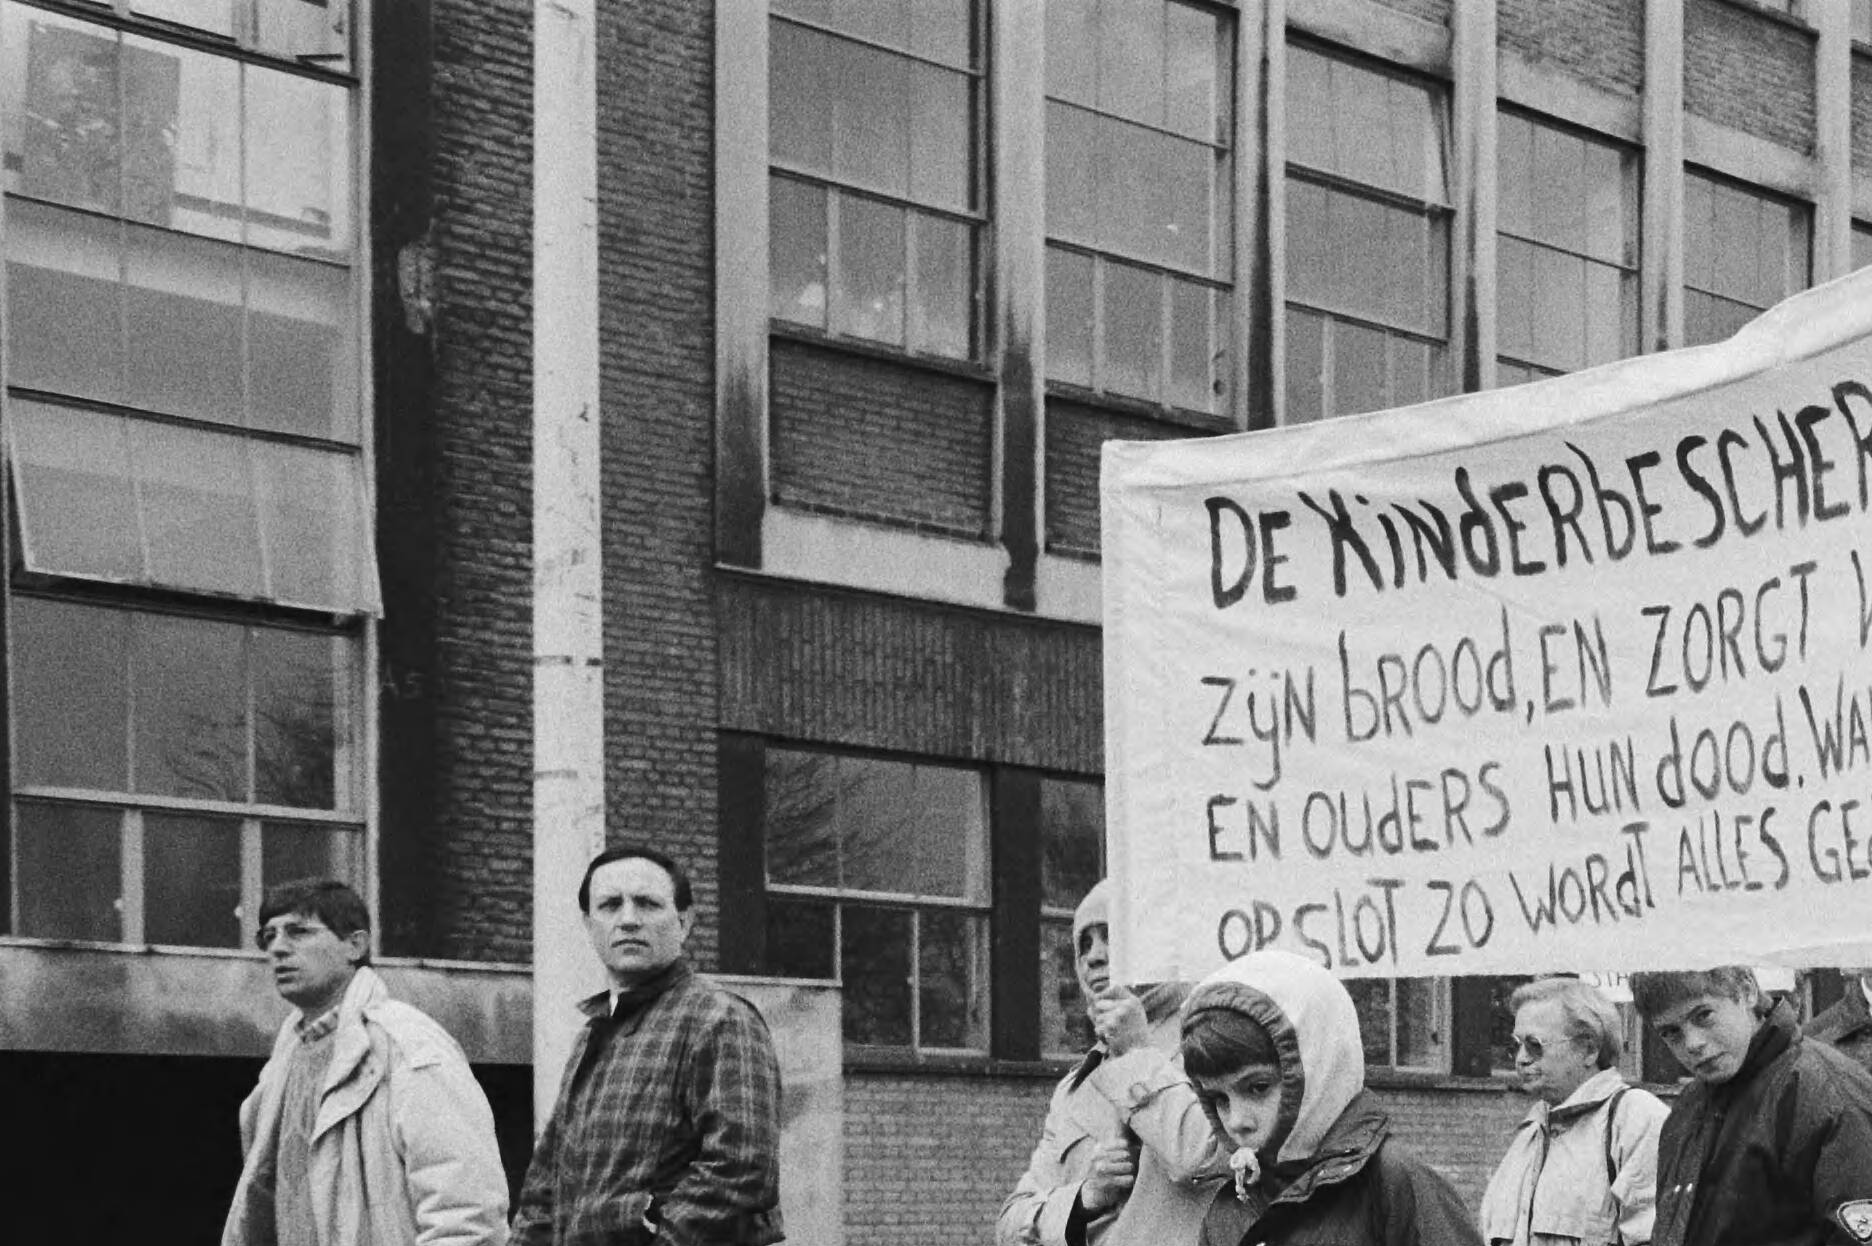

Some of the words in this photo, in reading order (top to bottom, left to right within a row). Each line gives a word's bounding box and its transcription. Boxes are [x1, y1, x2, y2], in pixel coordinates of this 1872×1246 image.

[1204, 494, 1297, 609] DE
[1641, 560, 1817, 699] ZORGT
[1206, 793, 1281, 863] EN
[1544, 737, 1639, 825] HUN
[1291, 878, 1405, 970] SLOT
[1425, 879, 1495, 957] ZO
[1677, 806, 1790, 896] ALLES
